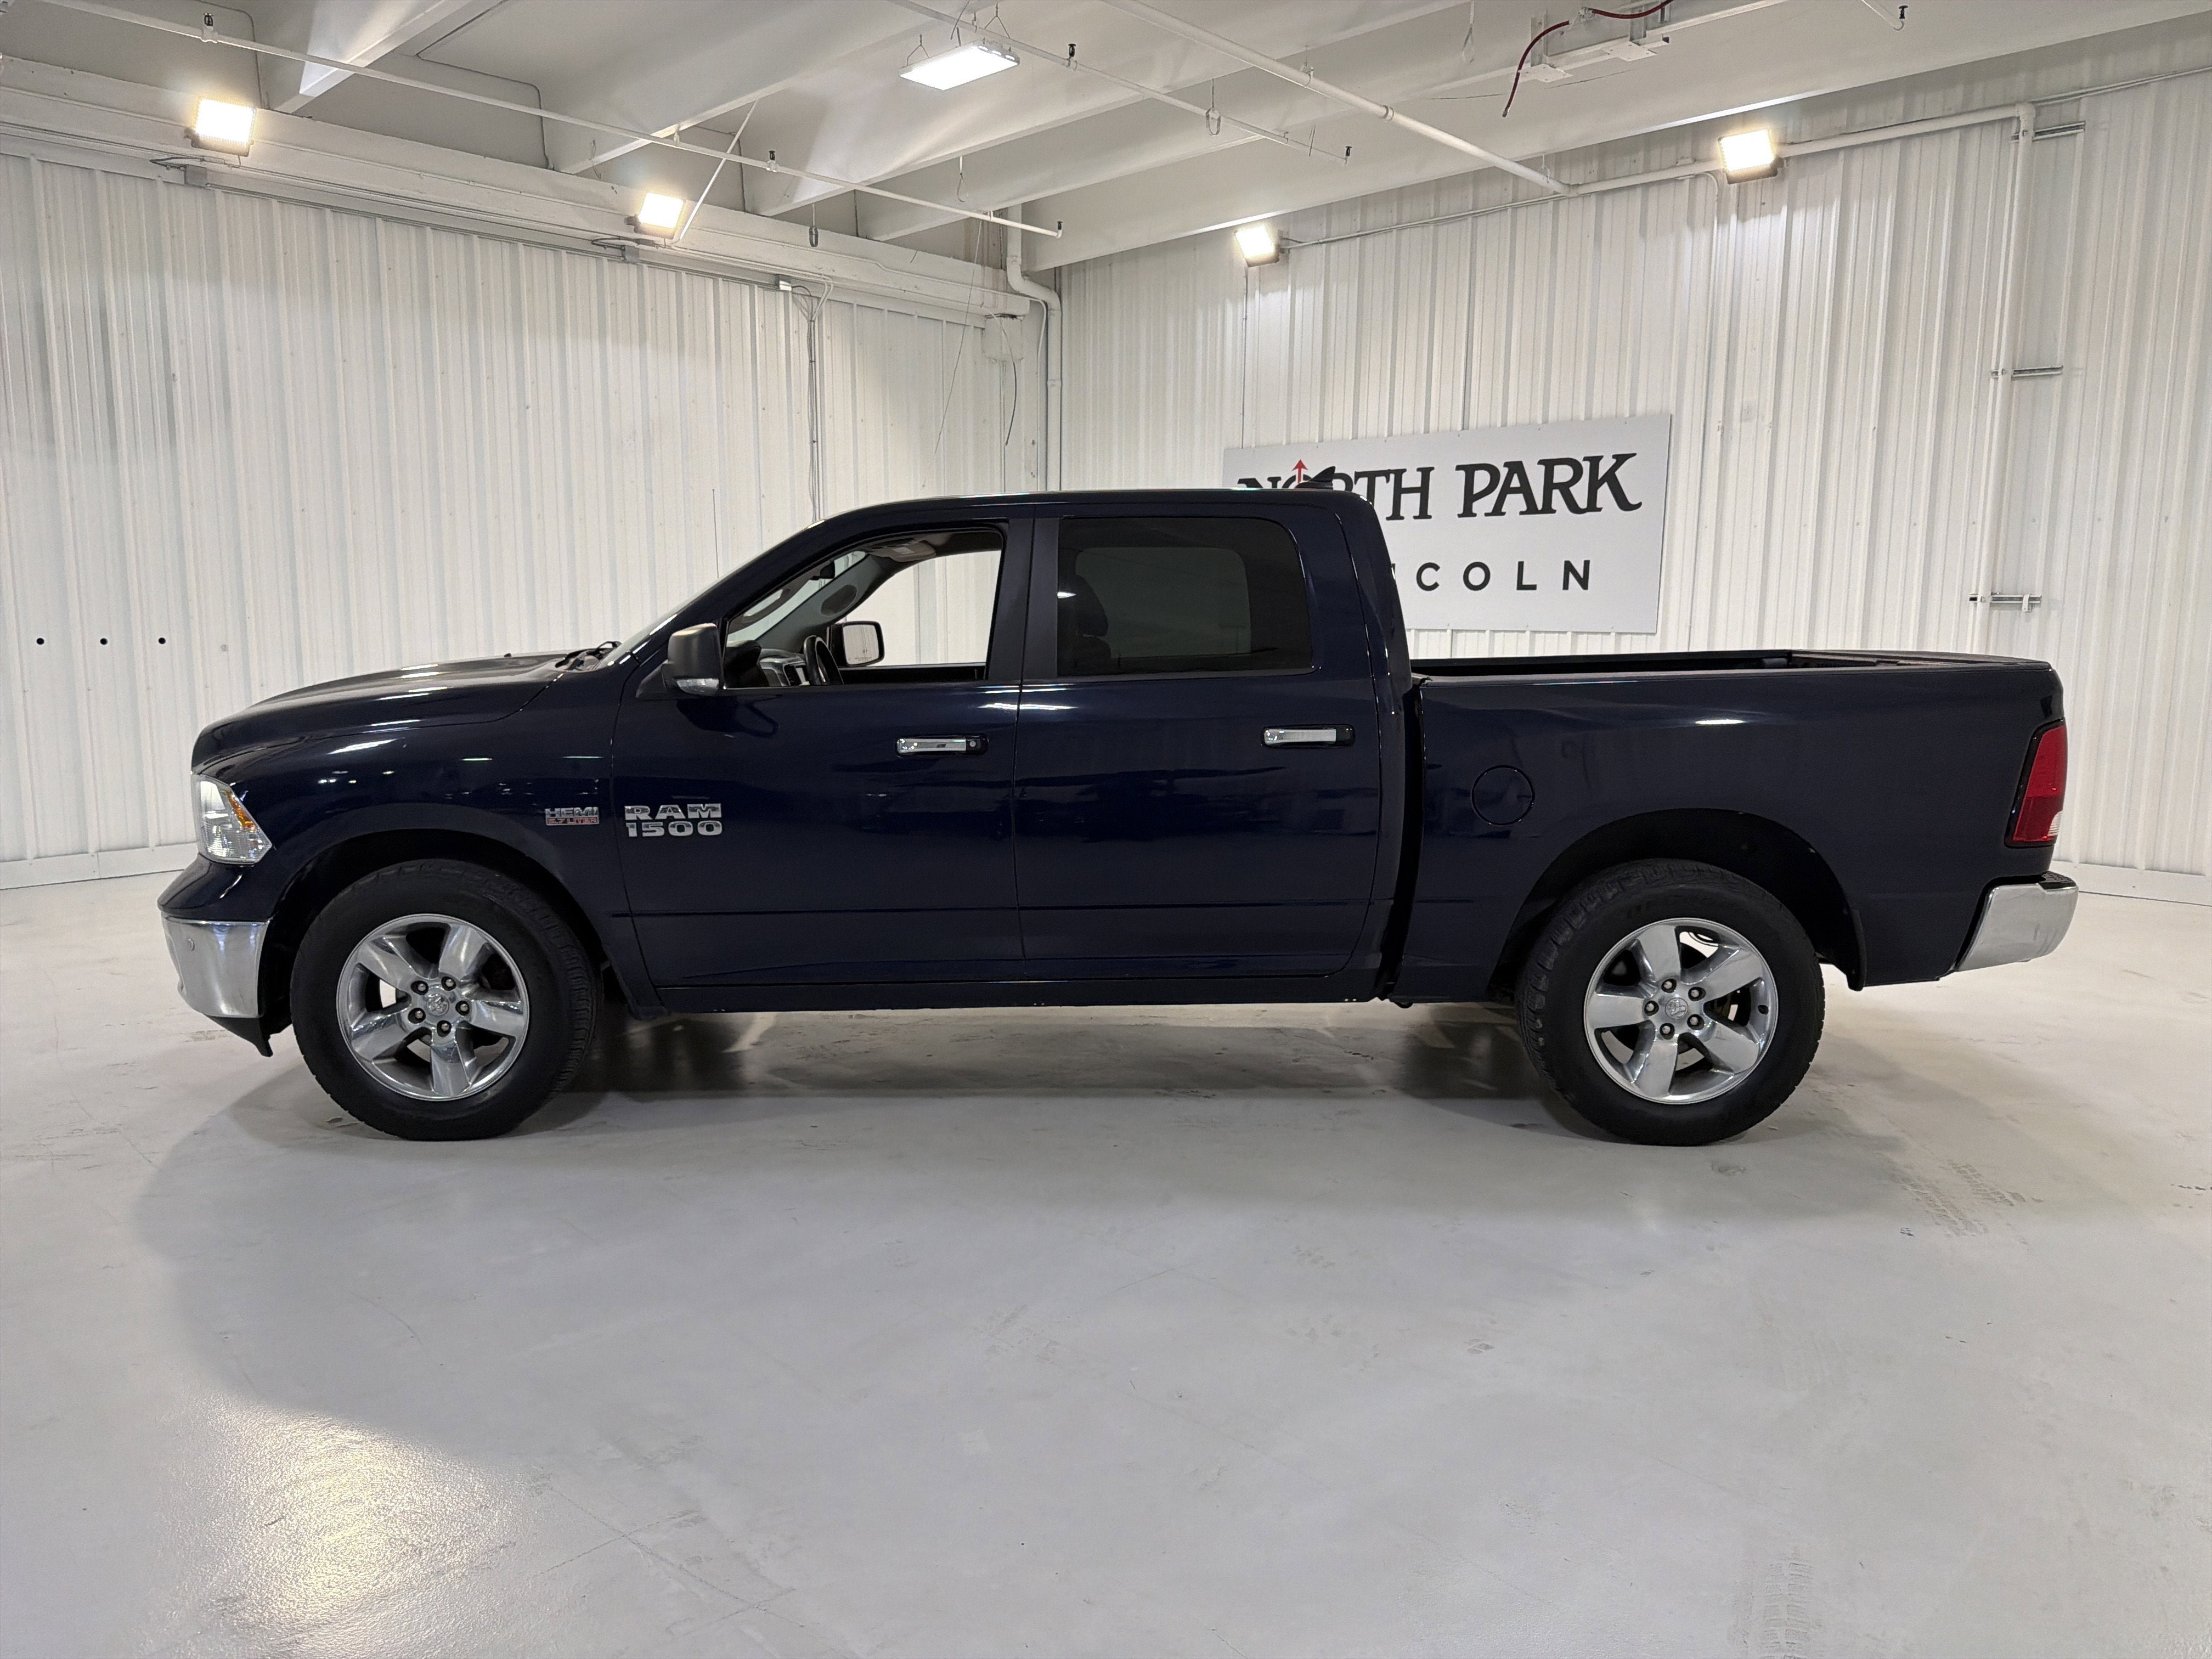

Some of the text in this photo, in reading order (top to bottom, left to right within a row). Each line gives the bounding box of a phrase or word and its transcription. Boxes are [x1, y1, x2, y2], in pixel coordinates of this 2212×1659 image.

[1455, 453, 1643, 518] PARK
[545, 807, 599, 817] HEMI
[624, 803, 723, 821] RAM
[626, 820, 723, 837] 1500
